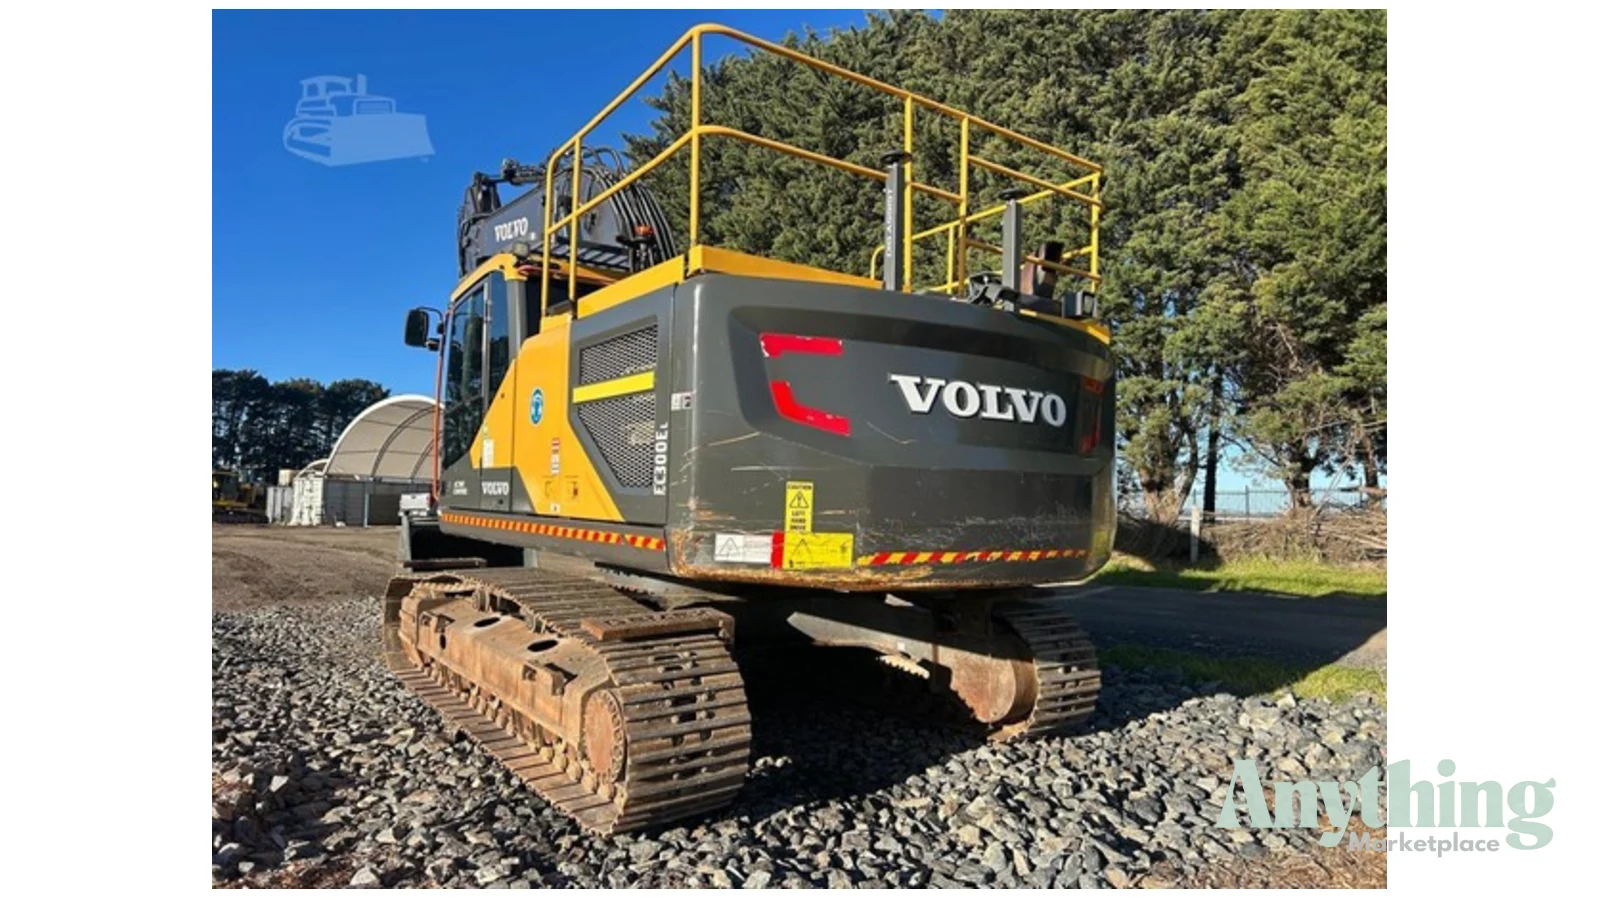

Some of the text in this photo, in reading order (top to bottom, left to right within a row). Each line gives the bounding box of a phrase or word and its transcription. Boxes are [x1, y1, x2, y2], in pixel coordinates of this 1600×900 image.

[495, 217, 528, 242] VOLVO
[889, 373, 1067, 428] VOLVO
[481, 480, 510, 496] VOLVO
